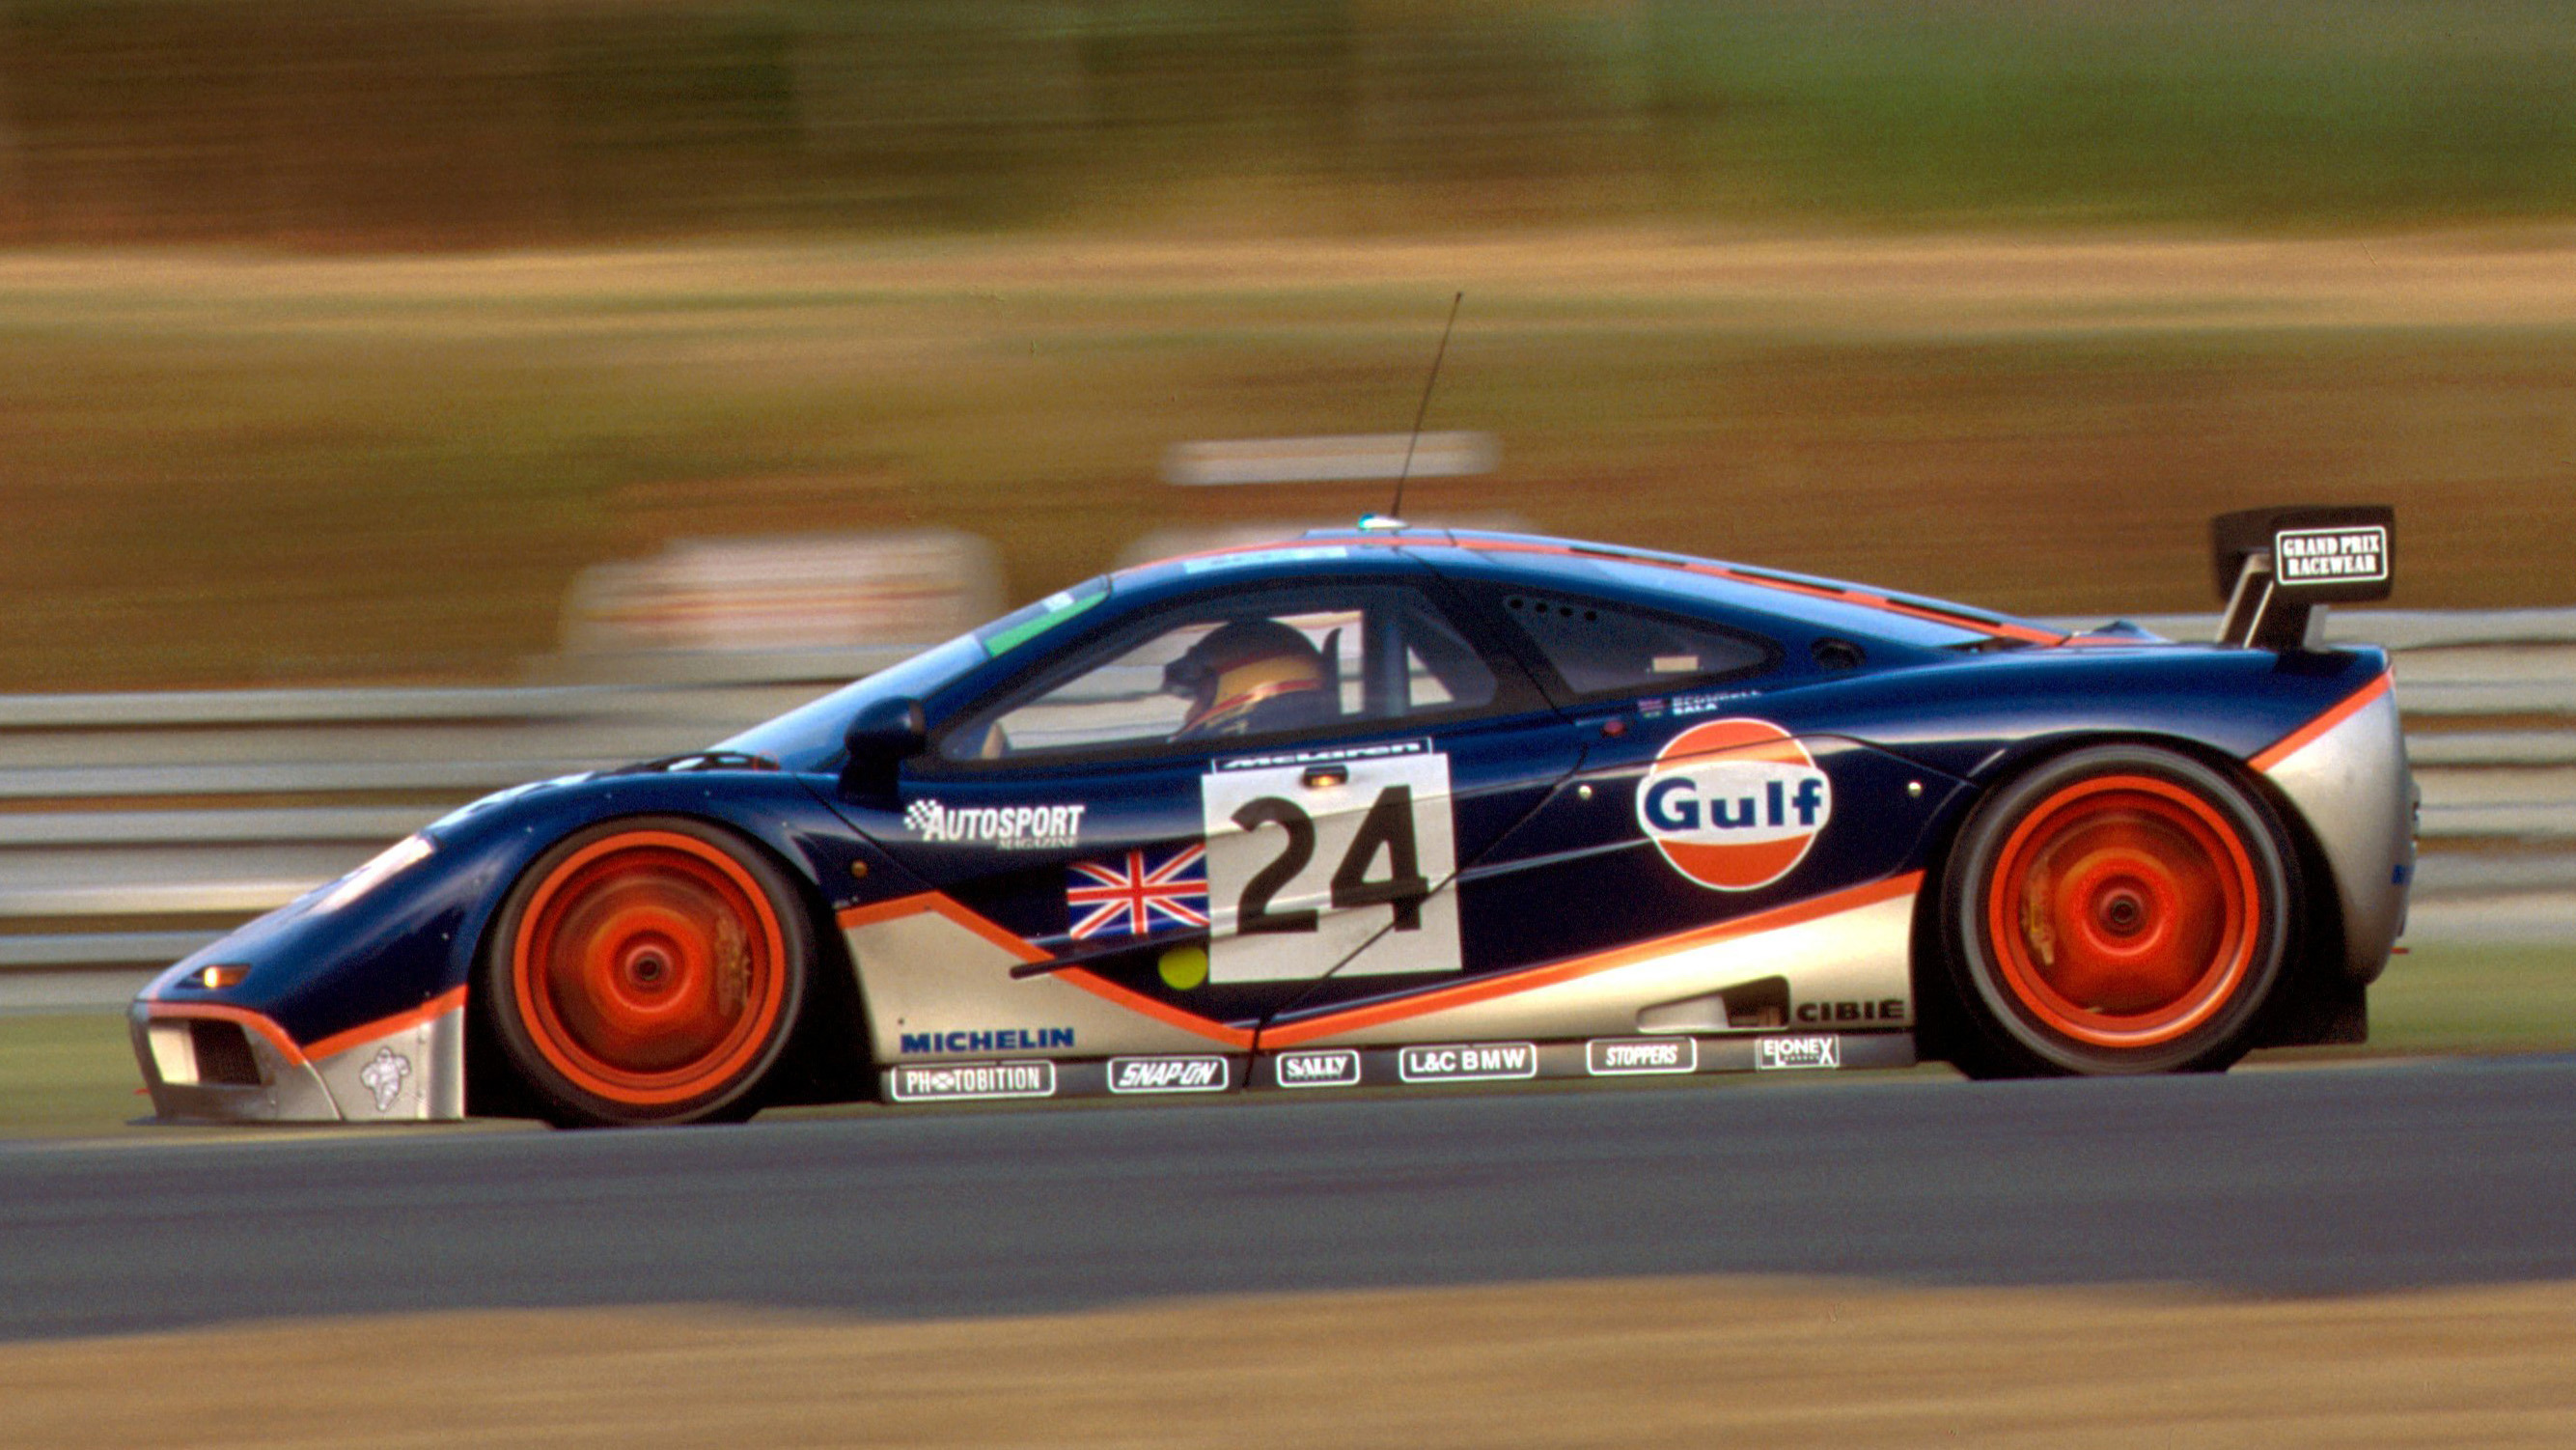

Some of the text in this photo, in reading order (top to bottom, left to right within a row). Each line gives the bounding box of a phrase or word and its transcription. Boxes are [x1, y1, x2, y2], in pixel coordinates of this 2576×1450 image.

[2283, 534, 2380, 557] GRAND PRIX
[2288, 554, 2377, 576] RACEWEAR
[1645, 776, 1823, 831] Gulf
[923, 804, 1086, 842] AUTOSPORT
[996, 836, 1079, 850] MAGAZINE
[1230, 784, 1428, 935] 24
[900, 1026, 1075, 1054] MICHELIN
[1763, 1035, 1835, 1067] ELONEX
[1286, 1055, 1348, 1078] SALLY
[1409, 1047, 1526, 1074] L&C BMW
[1605, 1046, 1679, 1067] STOPPERS
[1118, 1060, 1219, 1087] SNAP-ON
